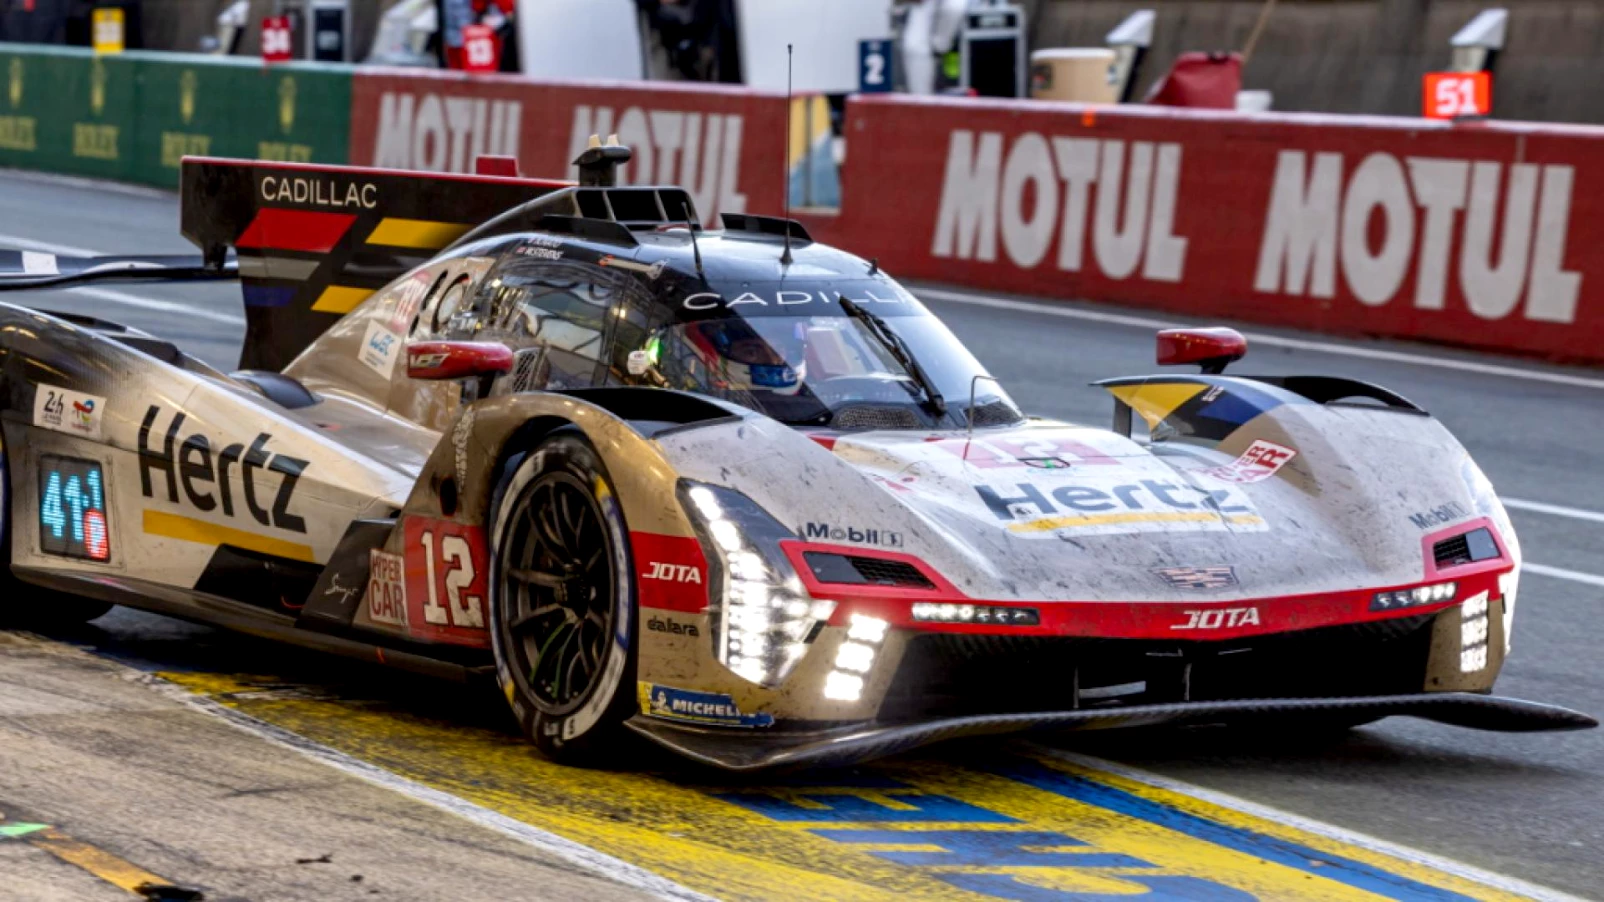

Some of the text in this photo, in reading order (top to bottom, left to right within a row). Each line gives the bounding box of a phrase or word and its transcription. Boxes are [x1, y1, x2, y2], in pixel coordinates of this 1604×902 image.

[865, 53, 885, 85] 2
[1436, 78, 1477, 115] 51
[261, 176, 378, 208] CADILLAC
[931, 130, 1188, 282] MOTUL
[1253, 150, 1583, 323] MOTUL
[138, 404, 310, 534] Hertz
[973, 479, 1250, 520] Hertz
[806, 522, 878, 545] Mobil
[421, 531, 485, 628] 12
[642, 561, 702, 585] JOTA
[1169, 606, 1260, 631] JOTA
